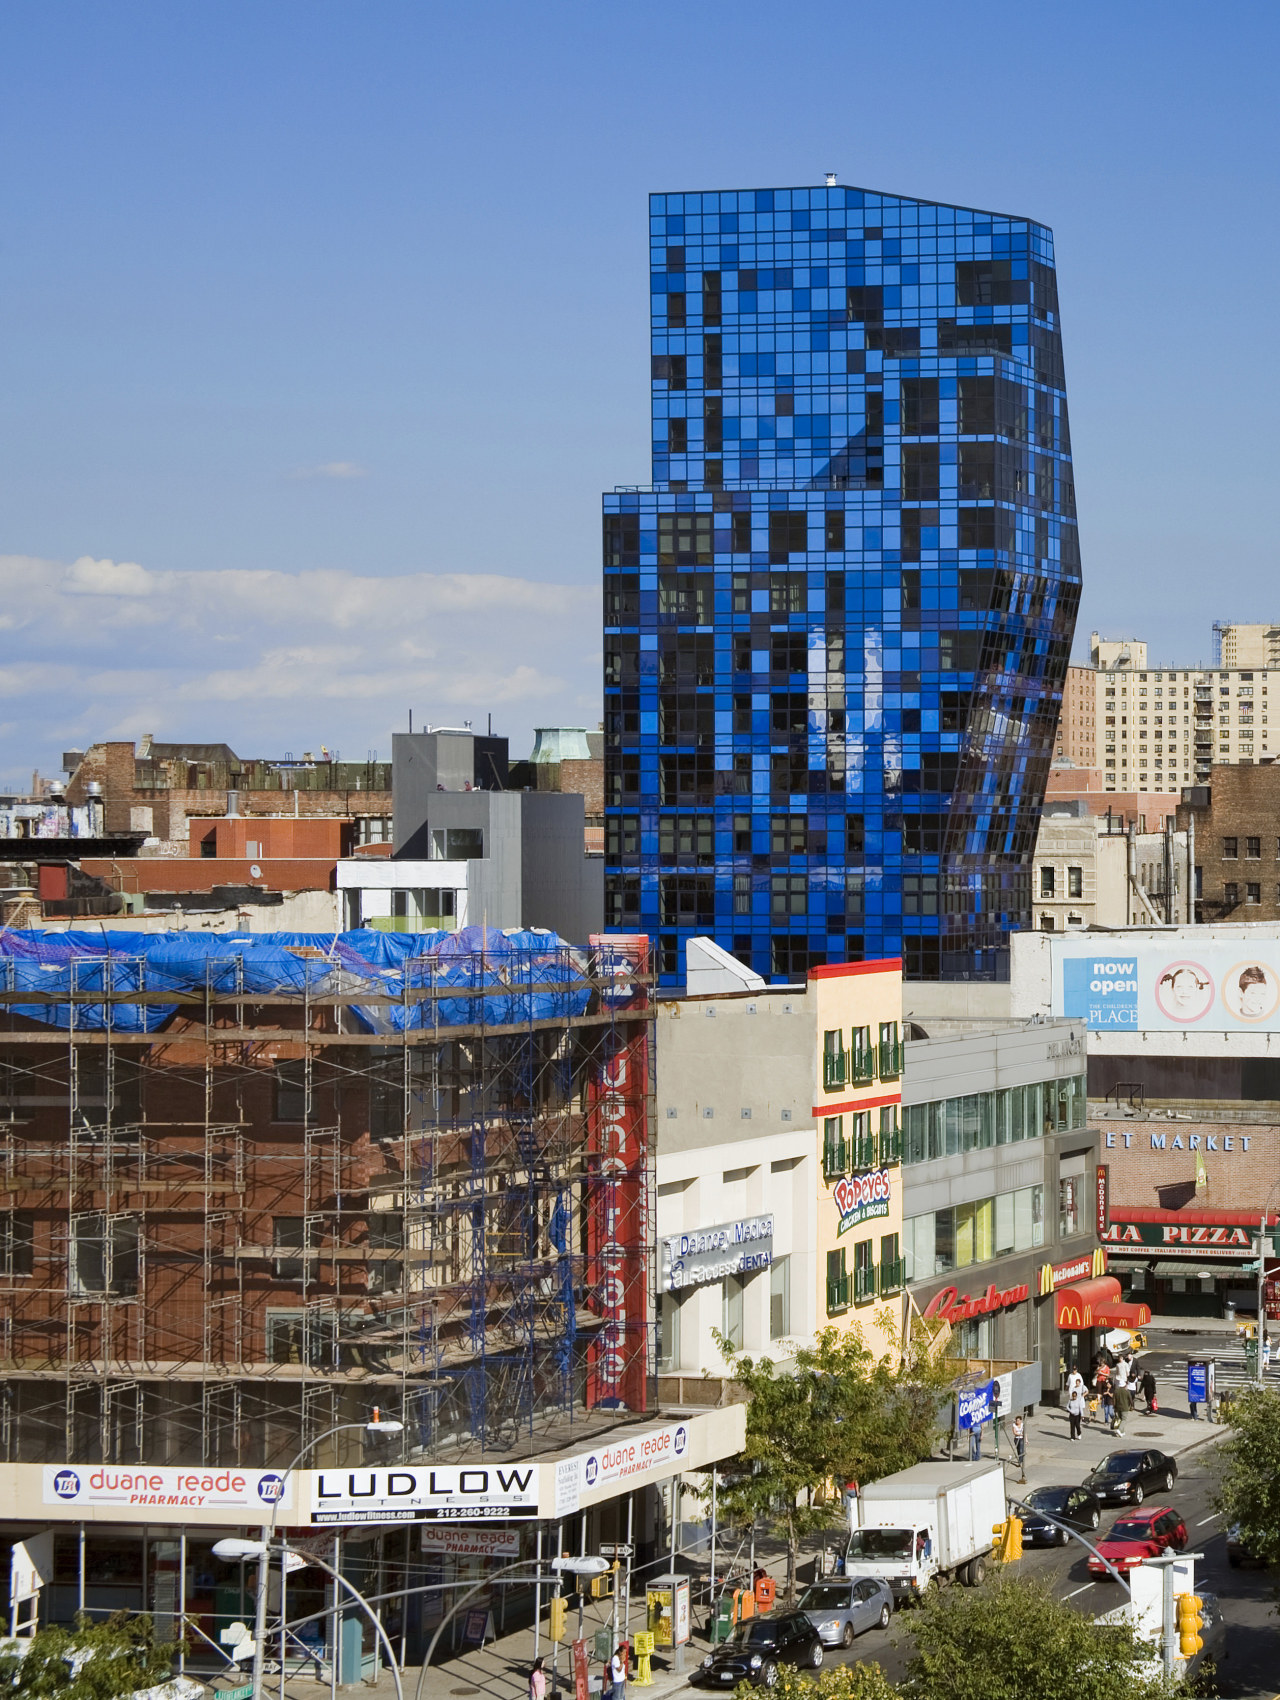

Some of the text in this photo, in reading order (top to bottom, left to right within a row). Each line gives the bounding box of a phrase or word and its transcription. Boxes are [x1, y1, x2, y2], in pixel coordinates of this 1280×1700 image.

[1093, 963, 1134, 975] now
[1089, 980, 1138, 996] open
[1089, 1009, 1139, 1023] PLACE
[1106, 1132, 1252, 1152] ET MARKET
[1098, 1178, 1106, 1229] McDonald's
[840, 1210, 861, 1233] CHICKEN
[866, 1203, 887, 1218] BISCUITS
[681, 1230, 730, 1257] Delancey
[1162, 1226, 1249, 1246] PIZZA
[1053, 1261, 1090, 1283] McDonald's
[924, 1285, 1029, 1325] Rainbow
[601, 1430, 671, 1470] duane reade
[619, 1458, 653, 1478] PHARMACY
[89, 1468, 247, 1493] duane reade
[318, 1469, 534, 1498] LUDLOW
[130, 1494, 206, 1506] PHARMACY
[318, 1495, 523, 1508] FITNESS
[316, 1507, 510, 1522] www.ludlowfitness.com 212-260-9222
[426, 1528, 515, 1545] duane reade
[445, 1544, 496, 1554] PHARMACY
